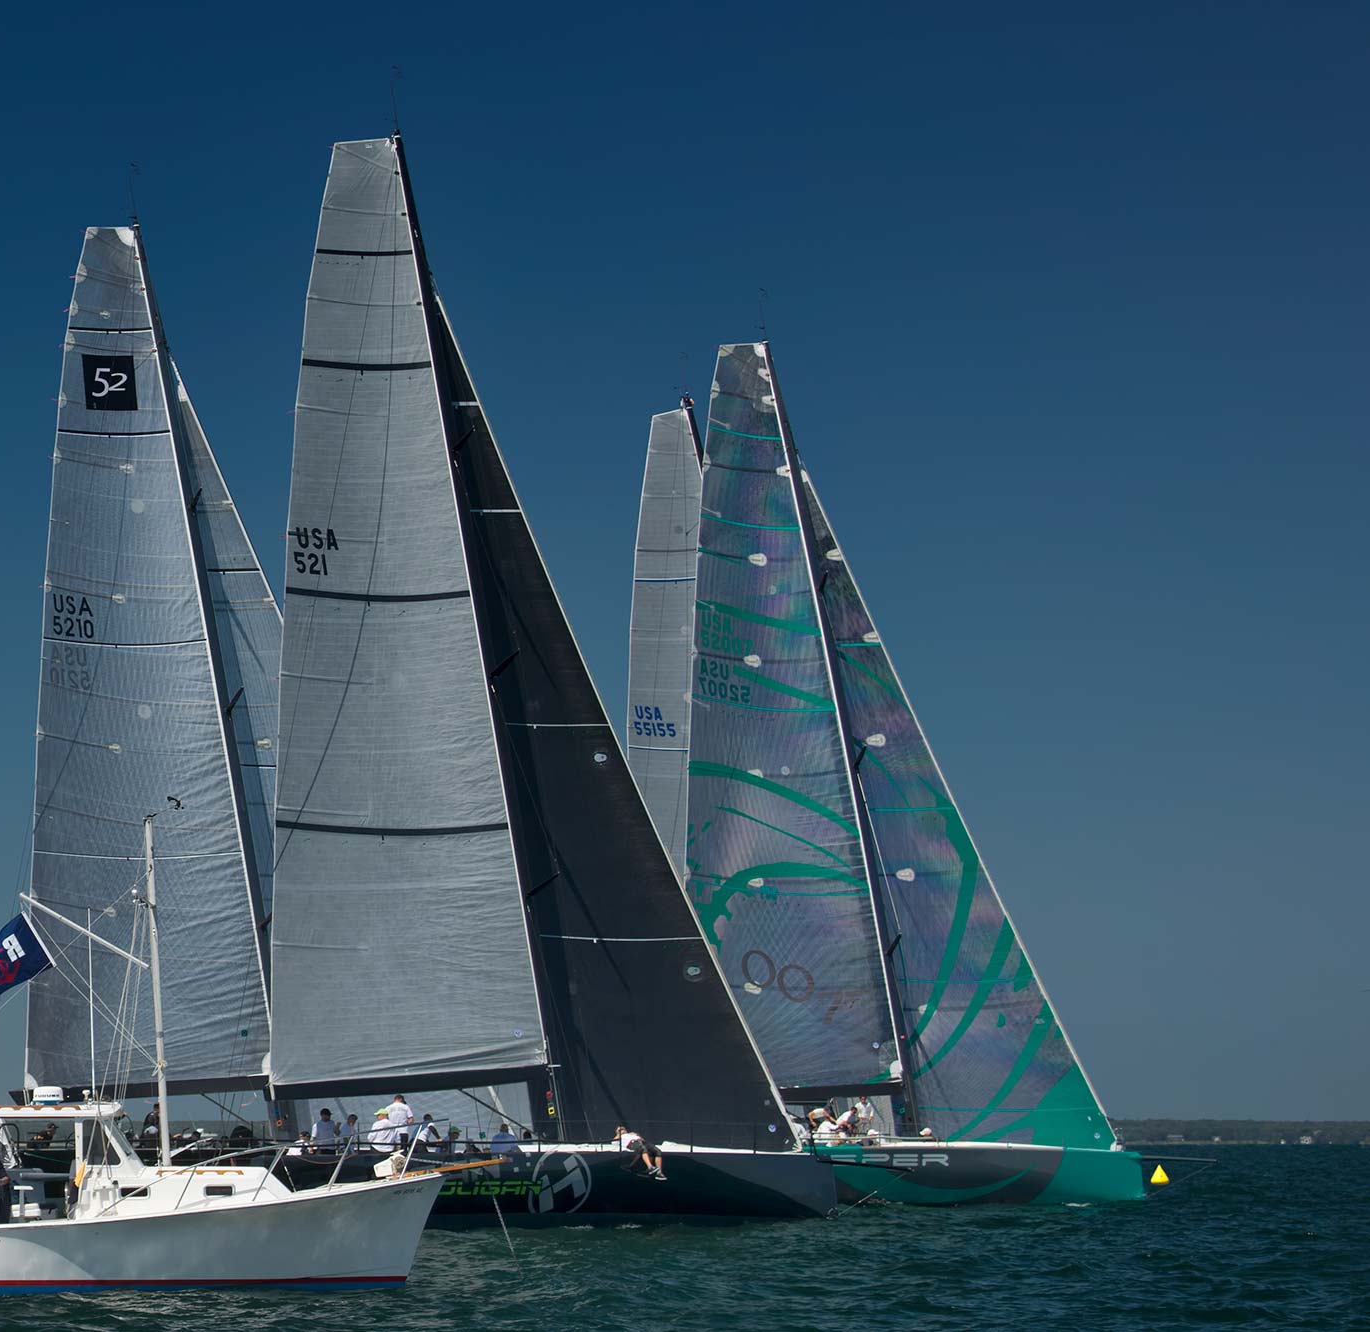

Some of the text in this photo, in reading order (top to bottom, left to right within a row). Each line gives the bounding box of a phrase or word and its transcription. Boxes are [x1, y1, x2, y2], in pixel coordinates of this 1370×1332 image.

[91, 367, 128, 398] 52
[295, 527, 339, 551] USA
[293, 551, 328, 576] 521
[53, 593, 94, 617] USA
[53, 615, 95, 639] 5210
[701, 611, 732, 634] USA
[634, 705, 663, 721] USA
[633, 721, 677, 738] 55155
